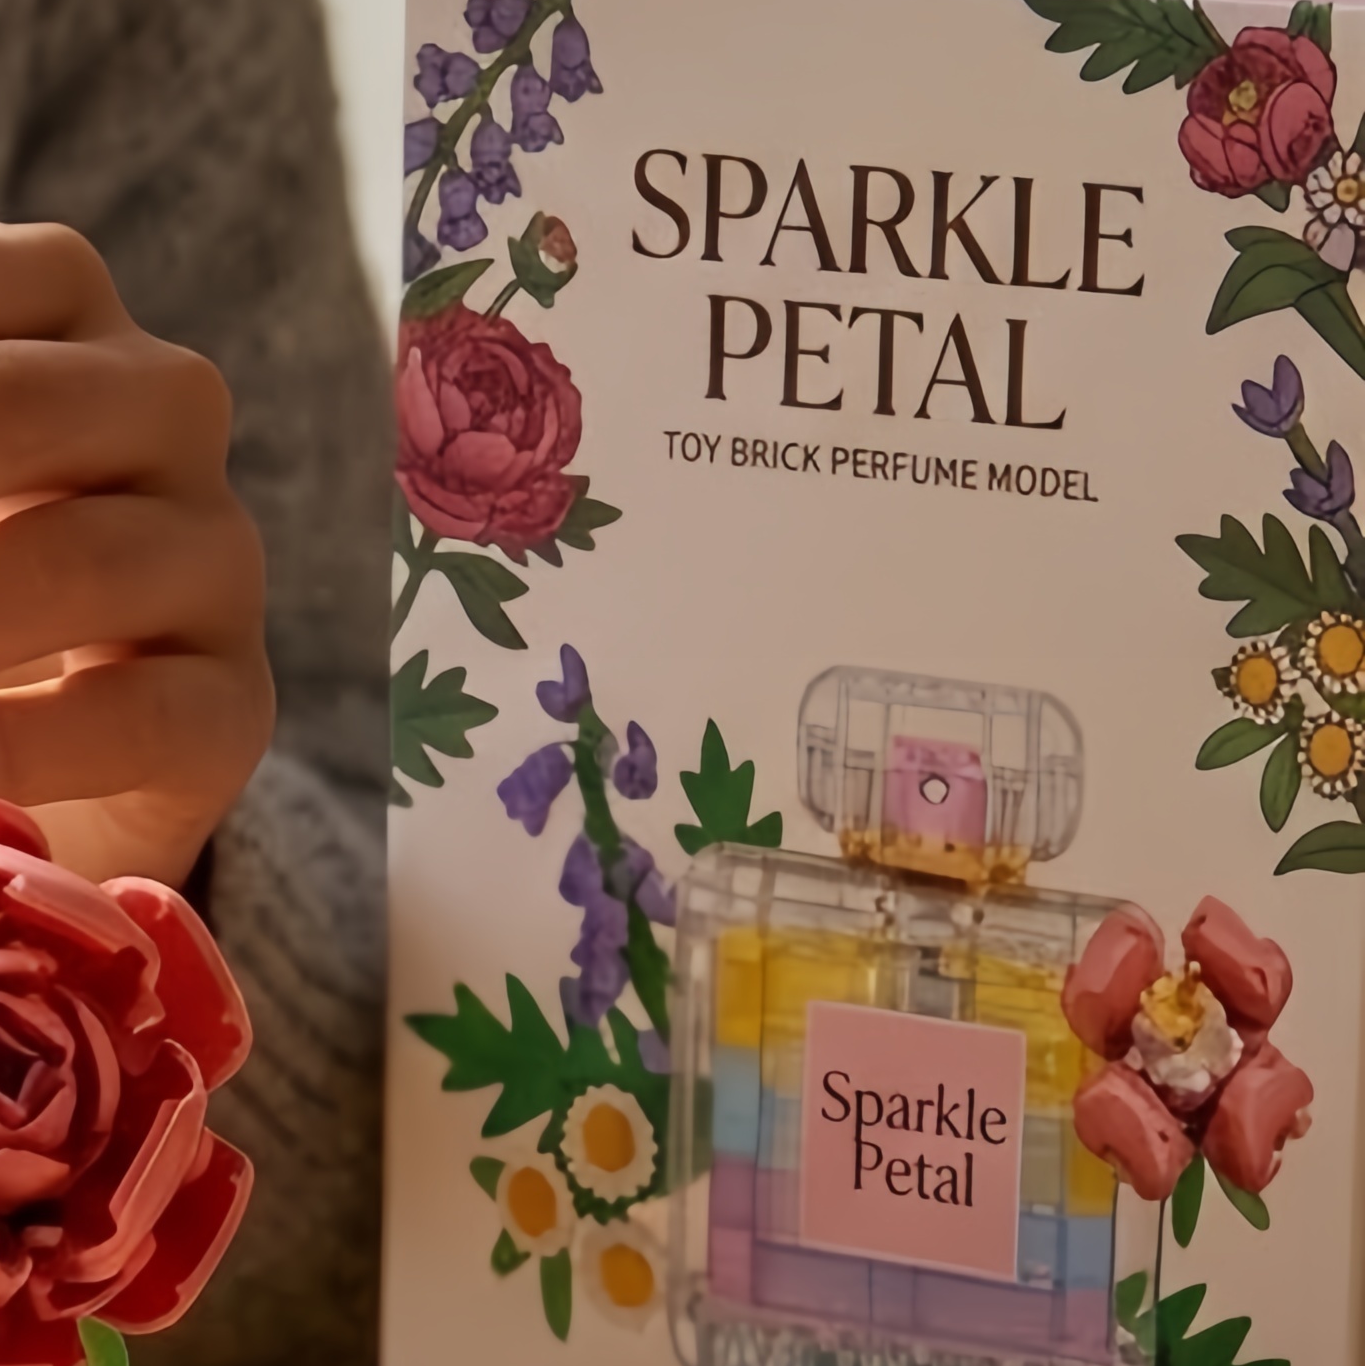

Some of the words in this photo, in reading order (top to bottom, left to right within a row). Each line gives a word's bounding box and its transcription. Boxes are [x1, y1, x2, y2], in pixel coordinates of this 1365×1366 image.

[631, 148, 1146, 297] SPARKLE
[704, 294, 1067, 431] PETAL
[663, 430, 722, 464] TOY
[731, 436, 822, 474] BRICK
[831, 446, 979, 491] PERFUME
[987, 462, 1100, 503] MODEL
[821, 1070, 1007, 1145] Sparkle
[853, 1137, 974, 1208] Petal
